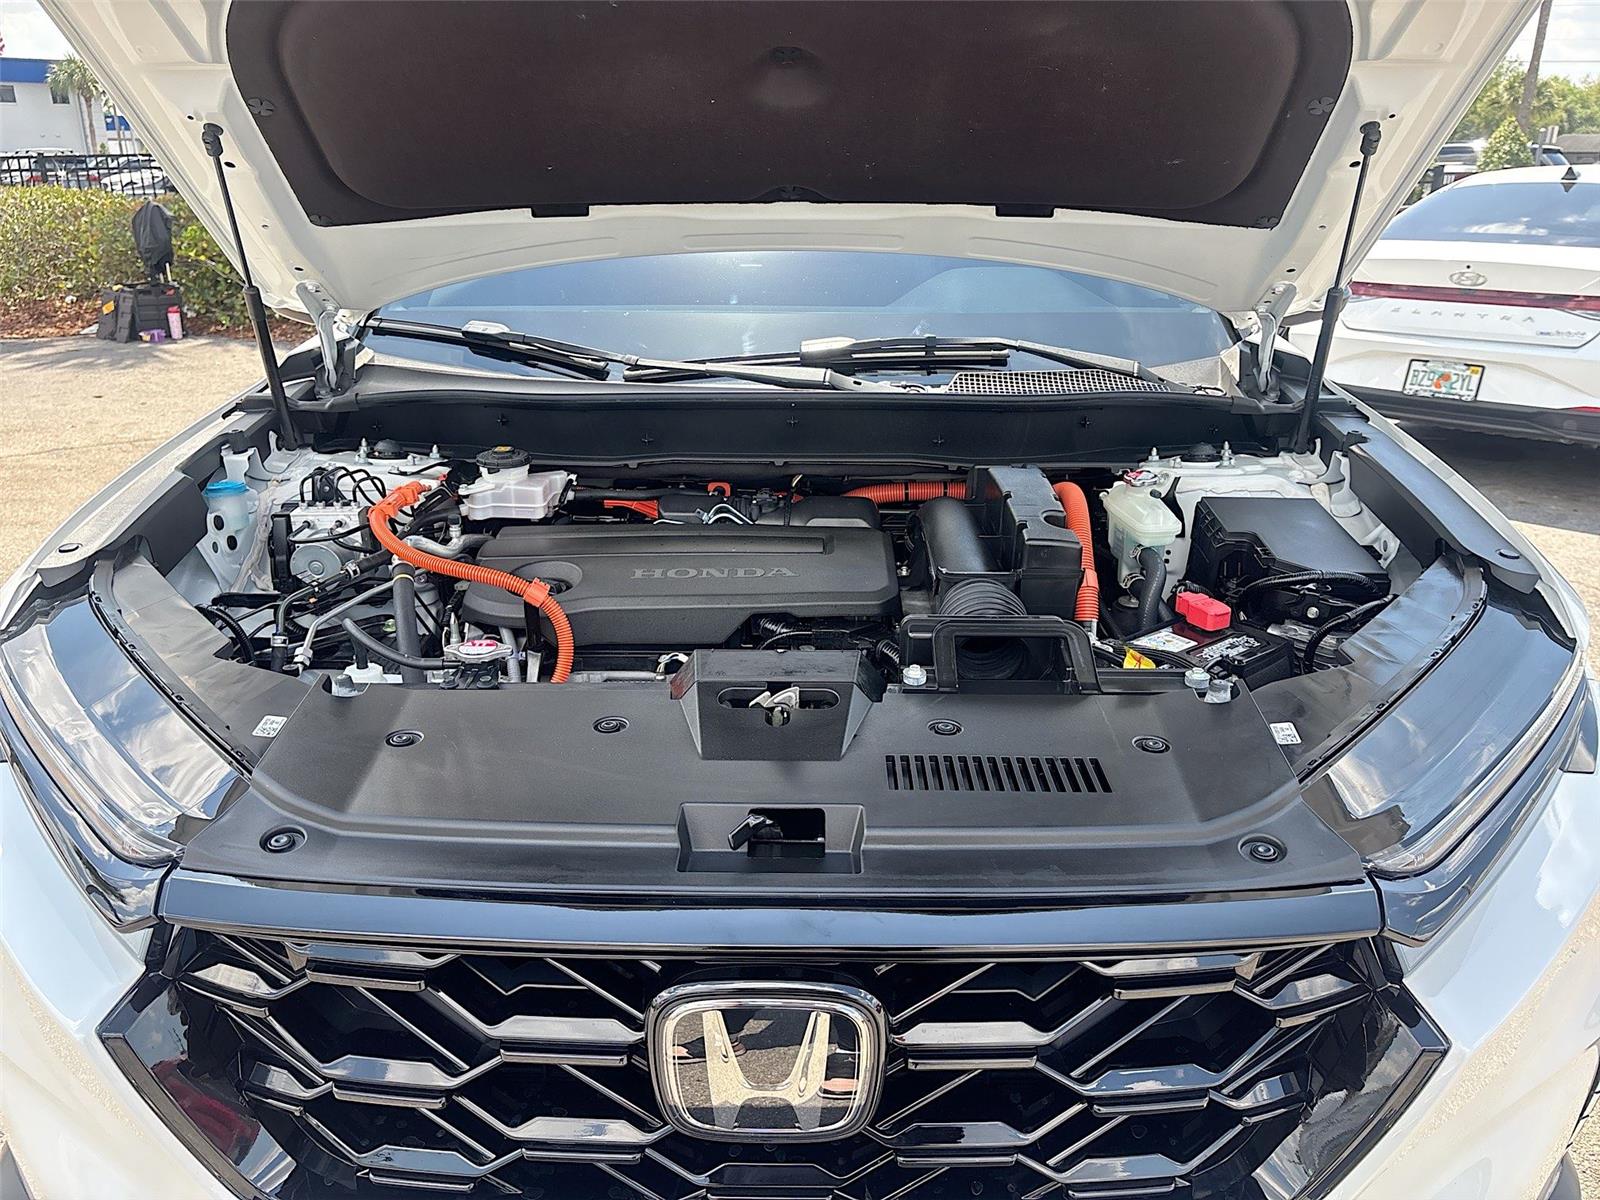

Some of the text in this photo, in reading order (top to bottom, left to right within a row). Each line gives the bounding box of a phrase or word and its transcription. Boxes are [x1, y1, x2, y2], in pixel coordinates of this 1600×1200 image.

[1391, 307, 1535, 323] ELANTRA
[1449, 373, 1474, 392] 2YL
[630, 567, 800, 579] HONDA
